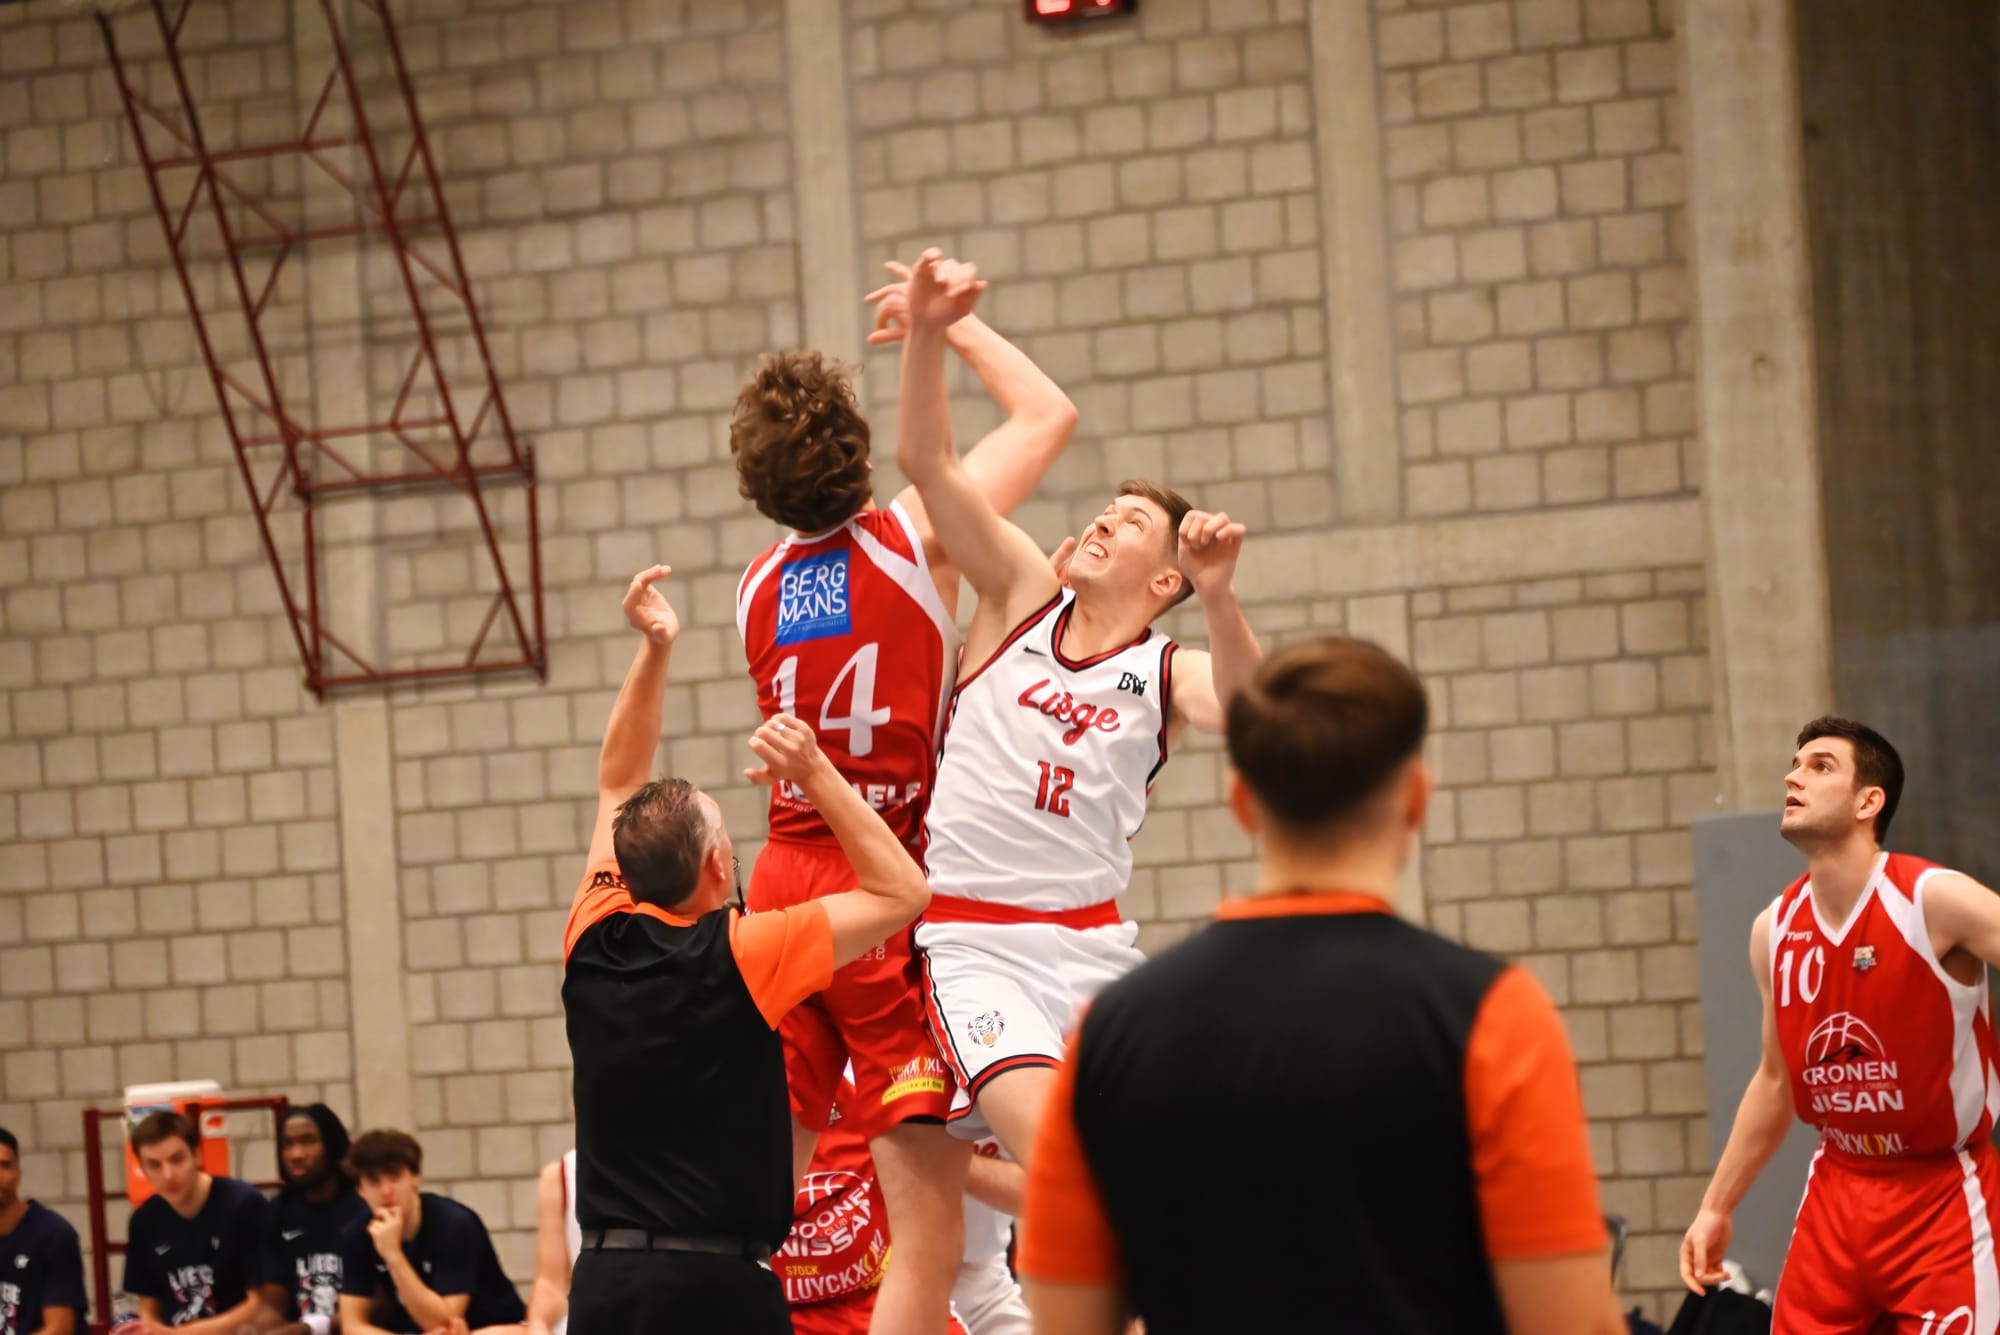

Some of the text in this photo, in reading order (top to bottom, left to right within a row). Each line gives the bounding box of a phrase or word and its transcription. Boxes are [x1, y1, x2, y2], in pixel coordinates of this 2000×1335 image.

[781, 562, 847, 600] BERG
[778, 588, 847, 626] MANS
[771, 642, 892, 757] 14
[1117, 672, 1147, 696] BW
[1035, 760, 1075, 818] 12
[1779, 945, 1826, 1008] 10
[785, 1265, 819, 1276] STOCK
